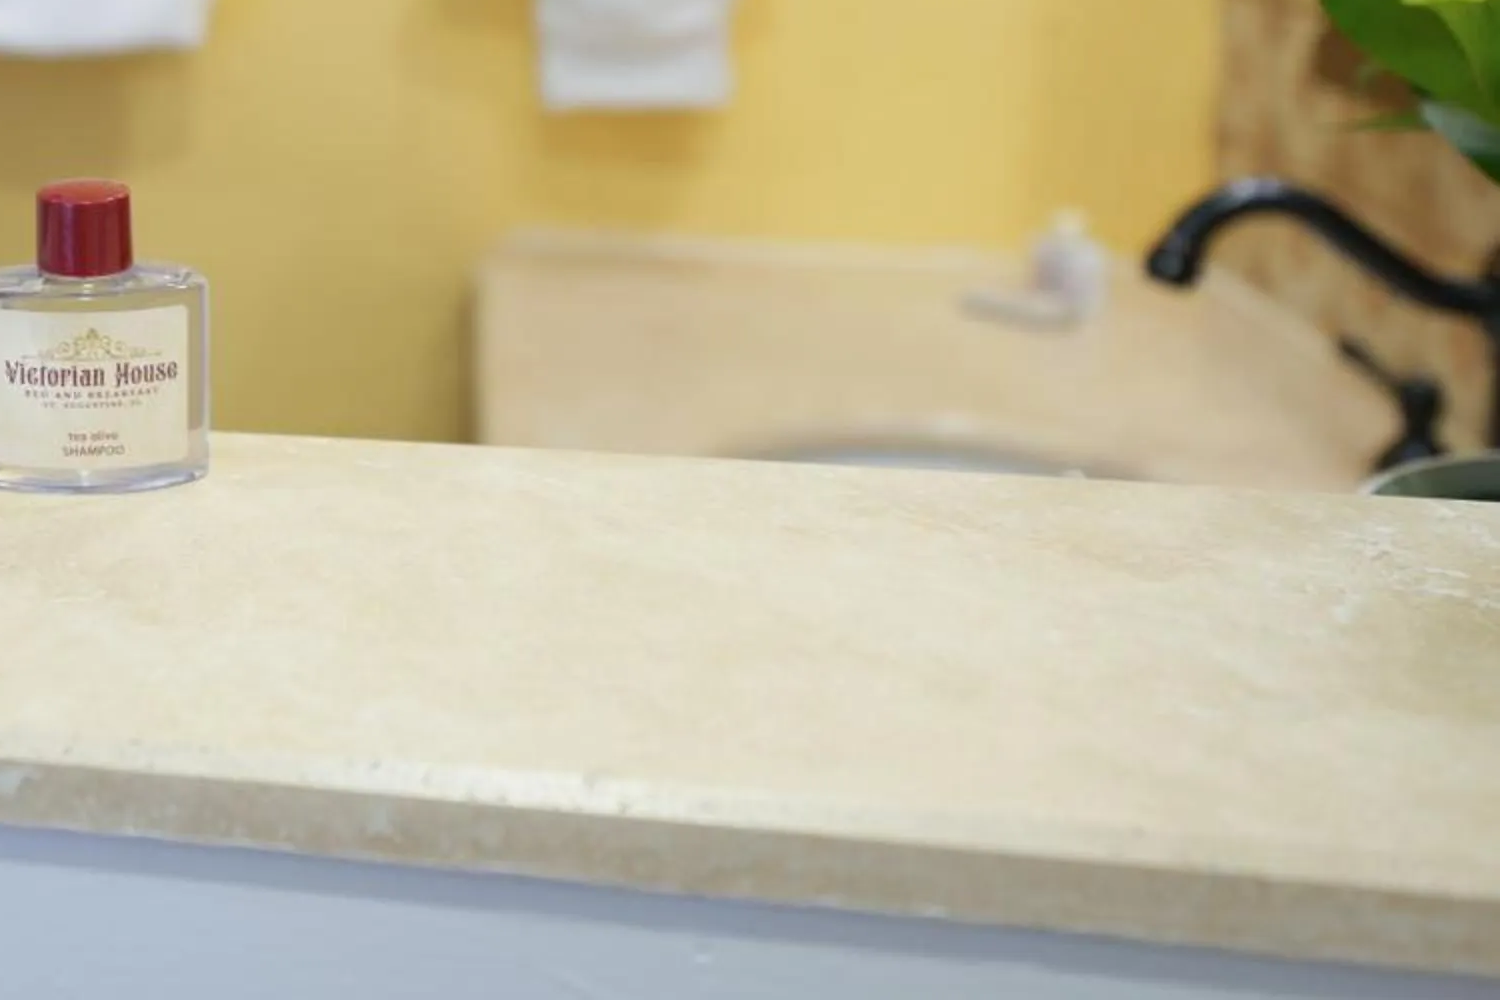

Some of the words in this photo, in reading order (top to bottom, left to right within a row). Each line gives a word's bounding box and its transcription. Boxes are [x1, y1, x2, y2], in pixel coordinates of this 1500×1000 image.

[5, 359, 105, 388] Victorian
[115, 360, 179, 388] House
[55, 391, 83, 400] AND
[67, 432, 88, 442] tea
[90, 430, 119, 442] olive
[61, 444, 126, 458] SHAMPOO
